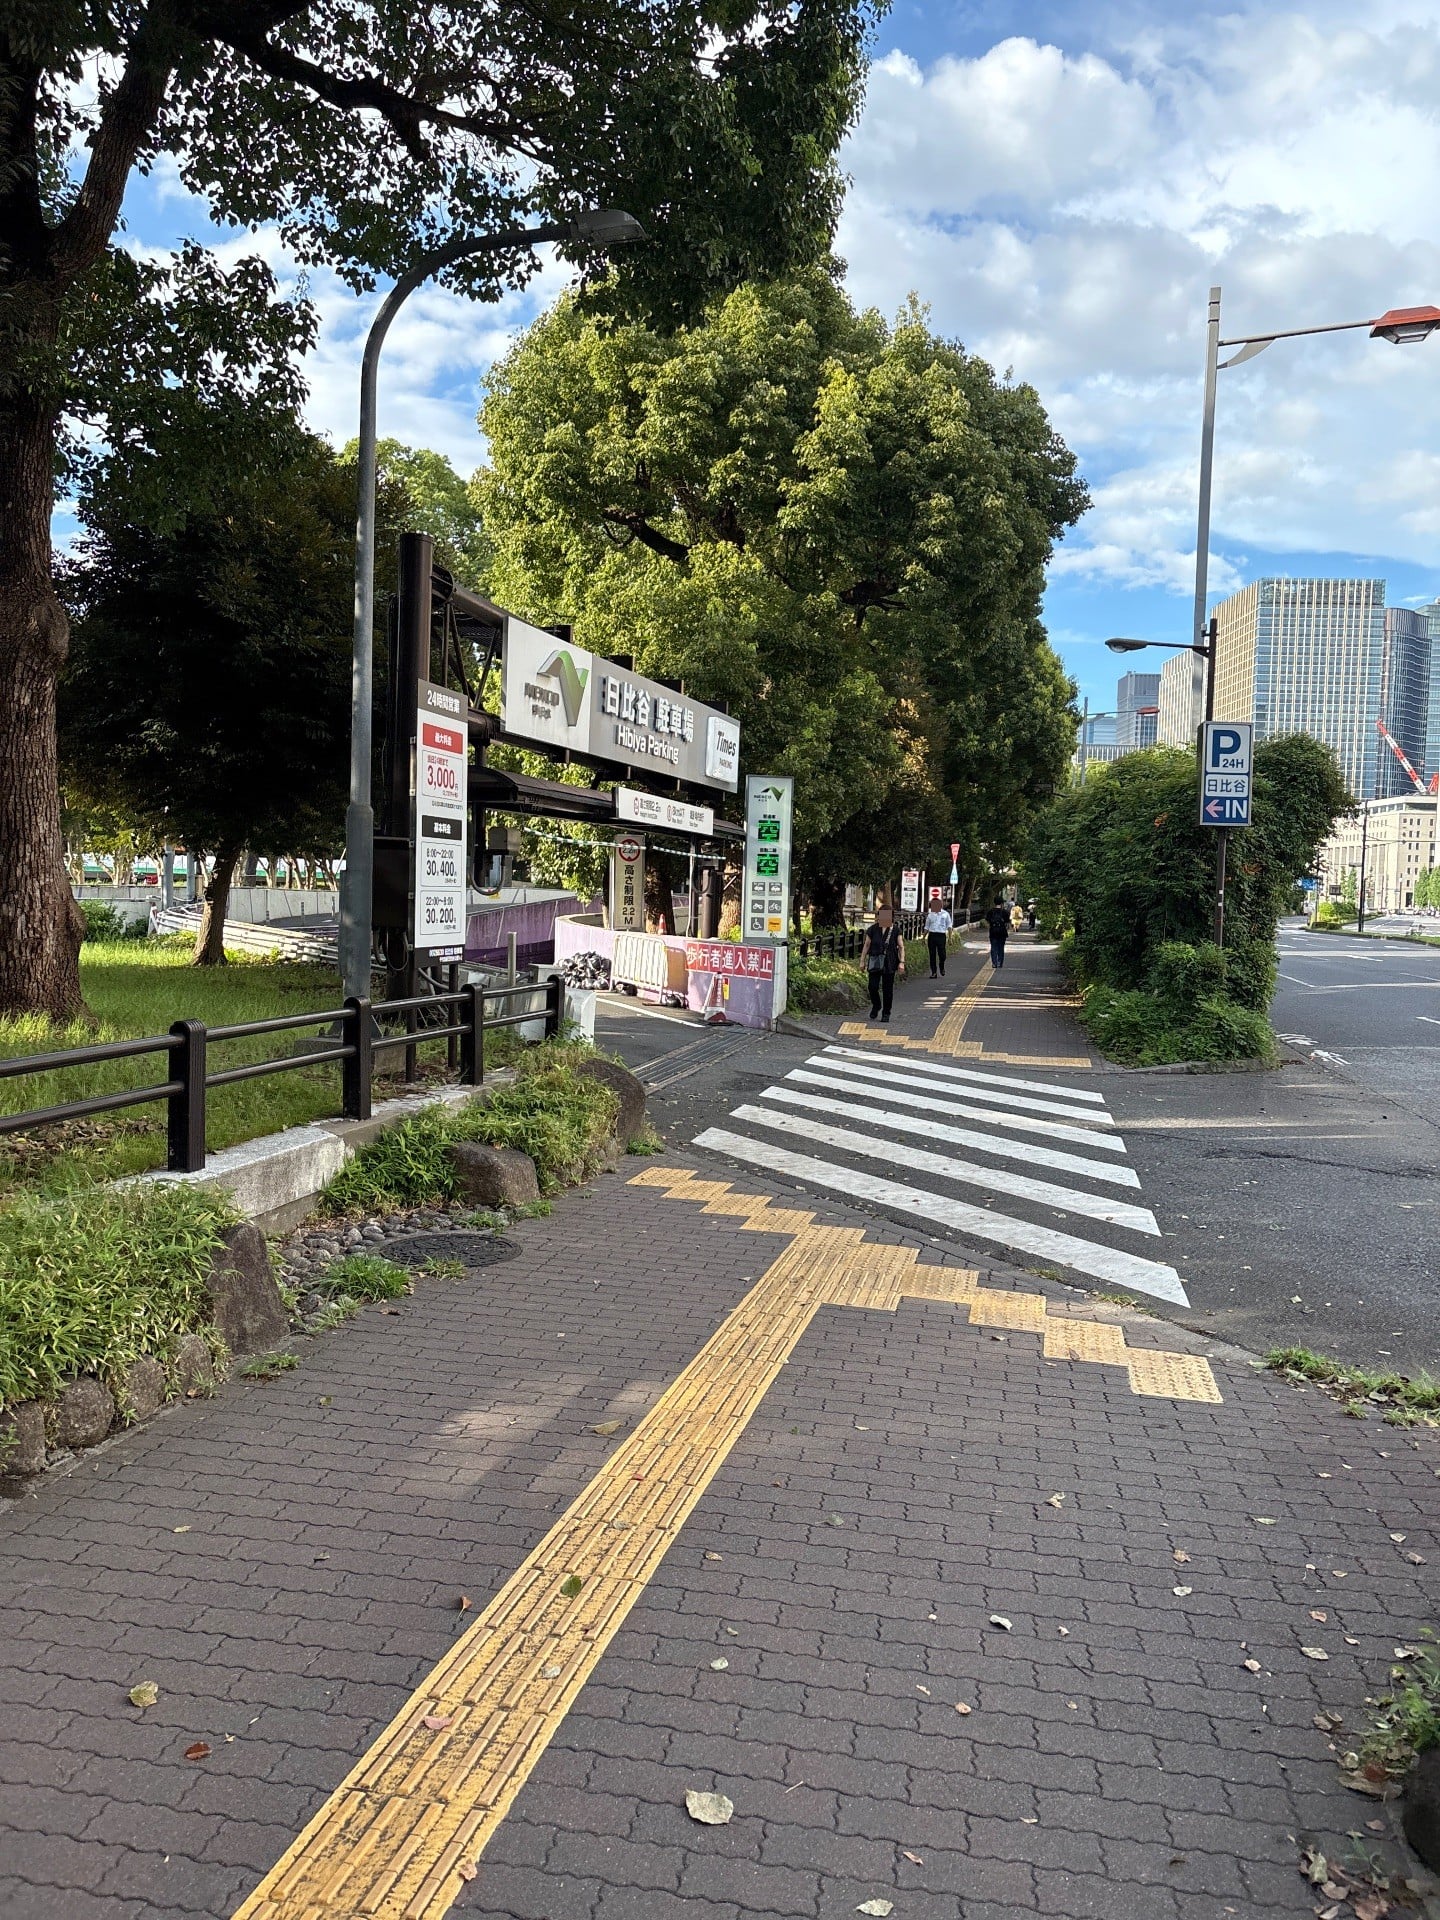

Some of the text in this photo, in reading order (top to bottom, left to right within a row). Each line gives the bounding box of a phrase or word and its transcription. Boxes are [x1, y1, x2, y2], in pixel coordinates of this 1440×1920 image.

[427, 690, 460, 713] 24時間営業
[605, 676, 693, 742] 日比谷 駐車場
[618, 724, 679, 765] Hibiya Parking
[716, 731, 736, 756] Times
[1211, 729, 1242, 768] P
[1222, 758, 1244, 769] 24H
[1207, 779, 1246, 793] 日比谷
[1225, 799, 1247, 818] IN
[757, 819, 781, 842] 空
[756, 853, 779, 876] 空
[686, 946, 773, 972] 歩行者進入禁止
